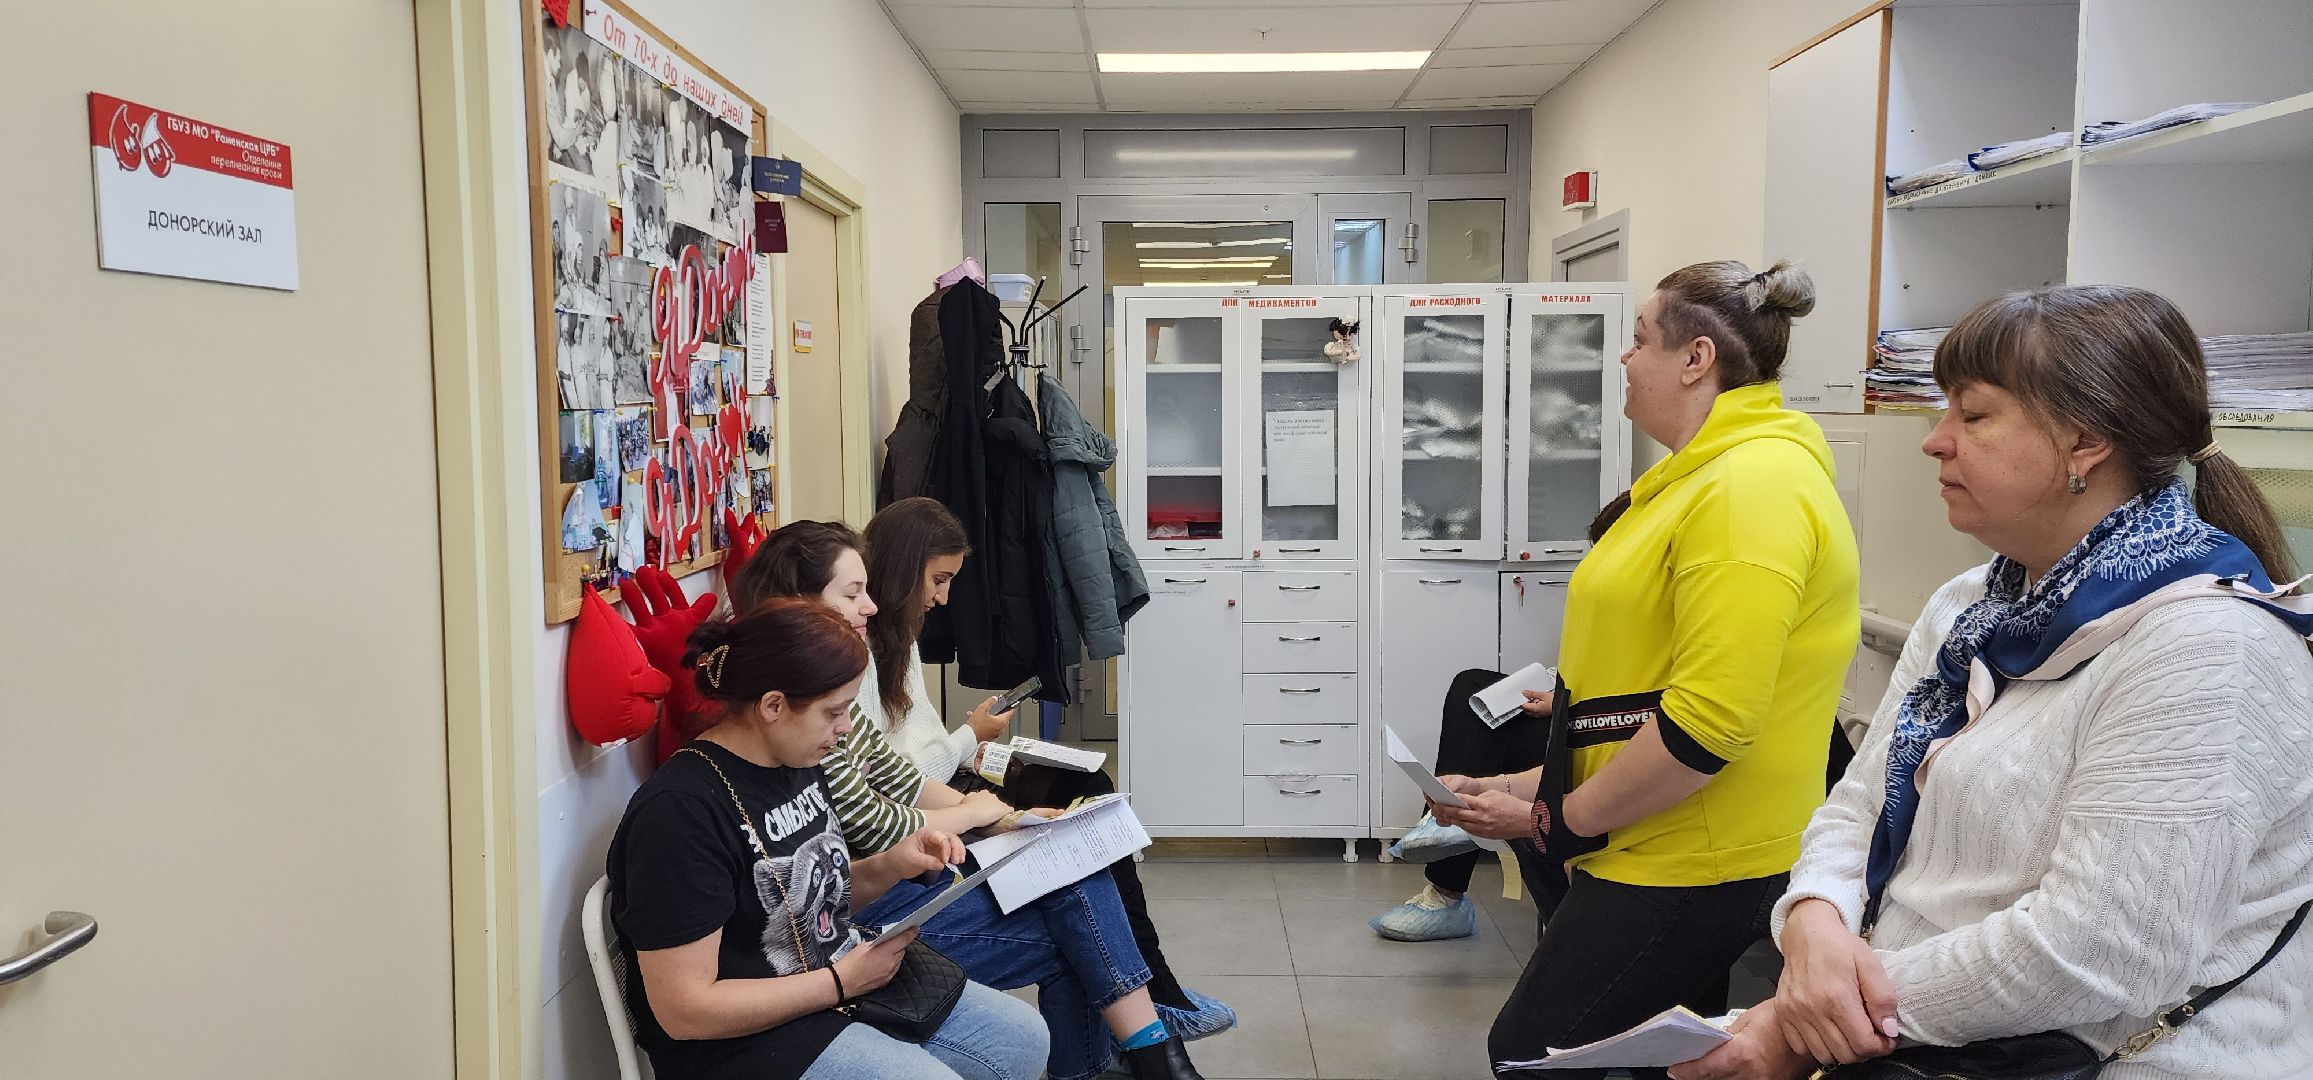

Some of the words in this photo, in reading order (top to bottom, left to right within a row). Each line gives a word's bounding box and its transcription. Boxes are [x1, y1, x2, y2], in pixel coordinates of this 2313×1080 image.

[604, 14, 626, 51] От
[633, 34, 658, 73] 70-х
[663, 55, 678, 84] до
[683, 74, 718, 110] наших
[721, 93, 744, 126] дней
[167, 117, 190, 134] ГБУЗ
[192, 125, 209, 139] МО
[260, 142, 280, 156] ЦРБ"
[211, 156, 260, 175] переливания
[260, 167, 282, 180] крови
[242, 150, 282, 170] Отделение
[148, 209, 235, 240] ДОНОРСКИЙ
[239, 225, 262, 244] ЗАЛ
[1222, 298, 1238, 308] ДЛЯ
[1248, 299, 1317, 308] МЕДИКАМЕНТОВ
[1409, 298, 1426, 307] ДЛЯ
[1430, 297, 1481, 306] РАСХОДНОГО
[1541, 295, 1591, 303] МАТЕРИАЛА
